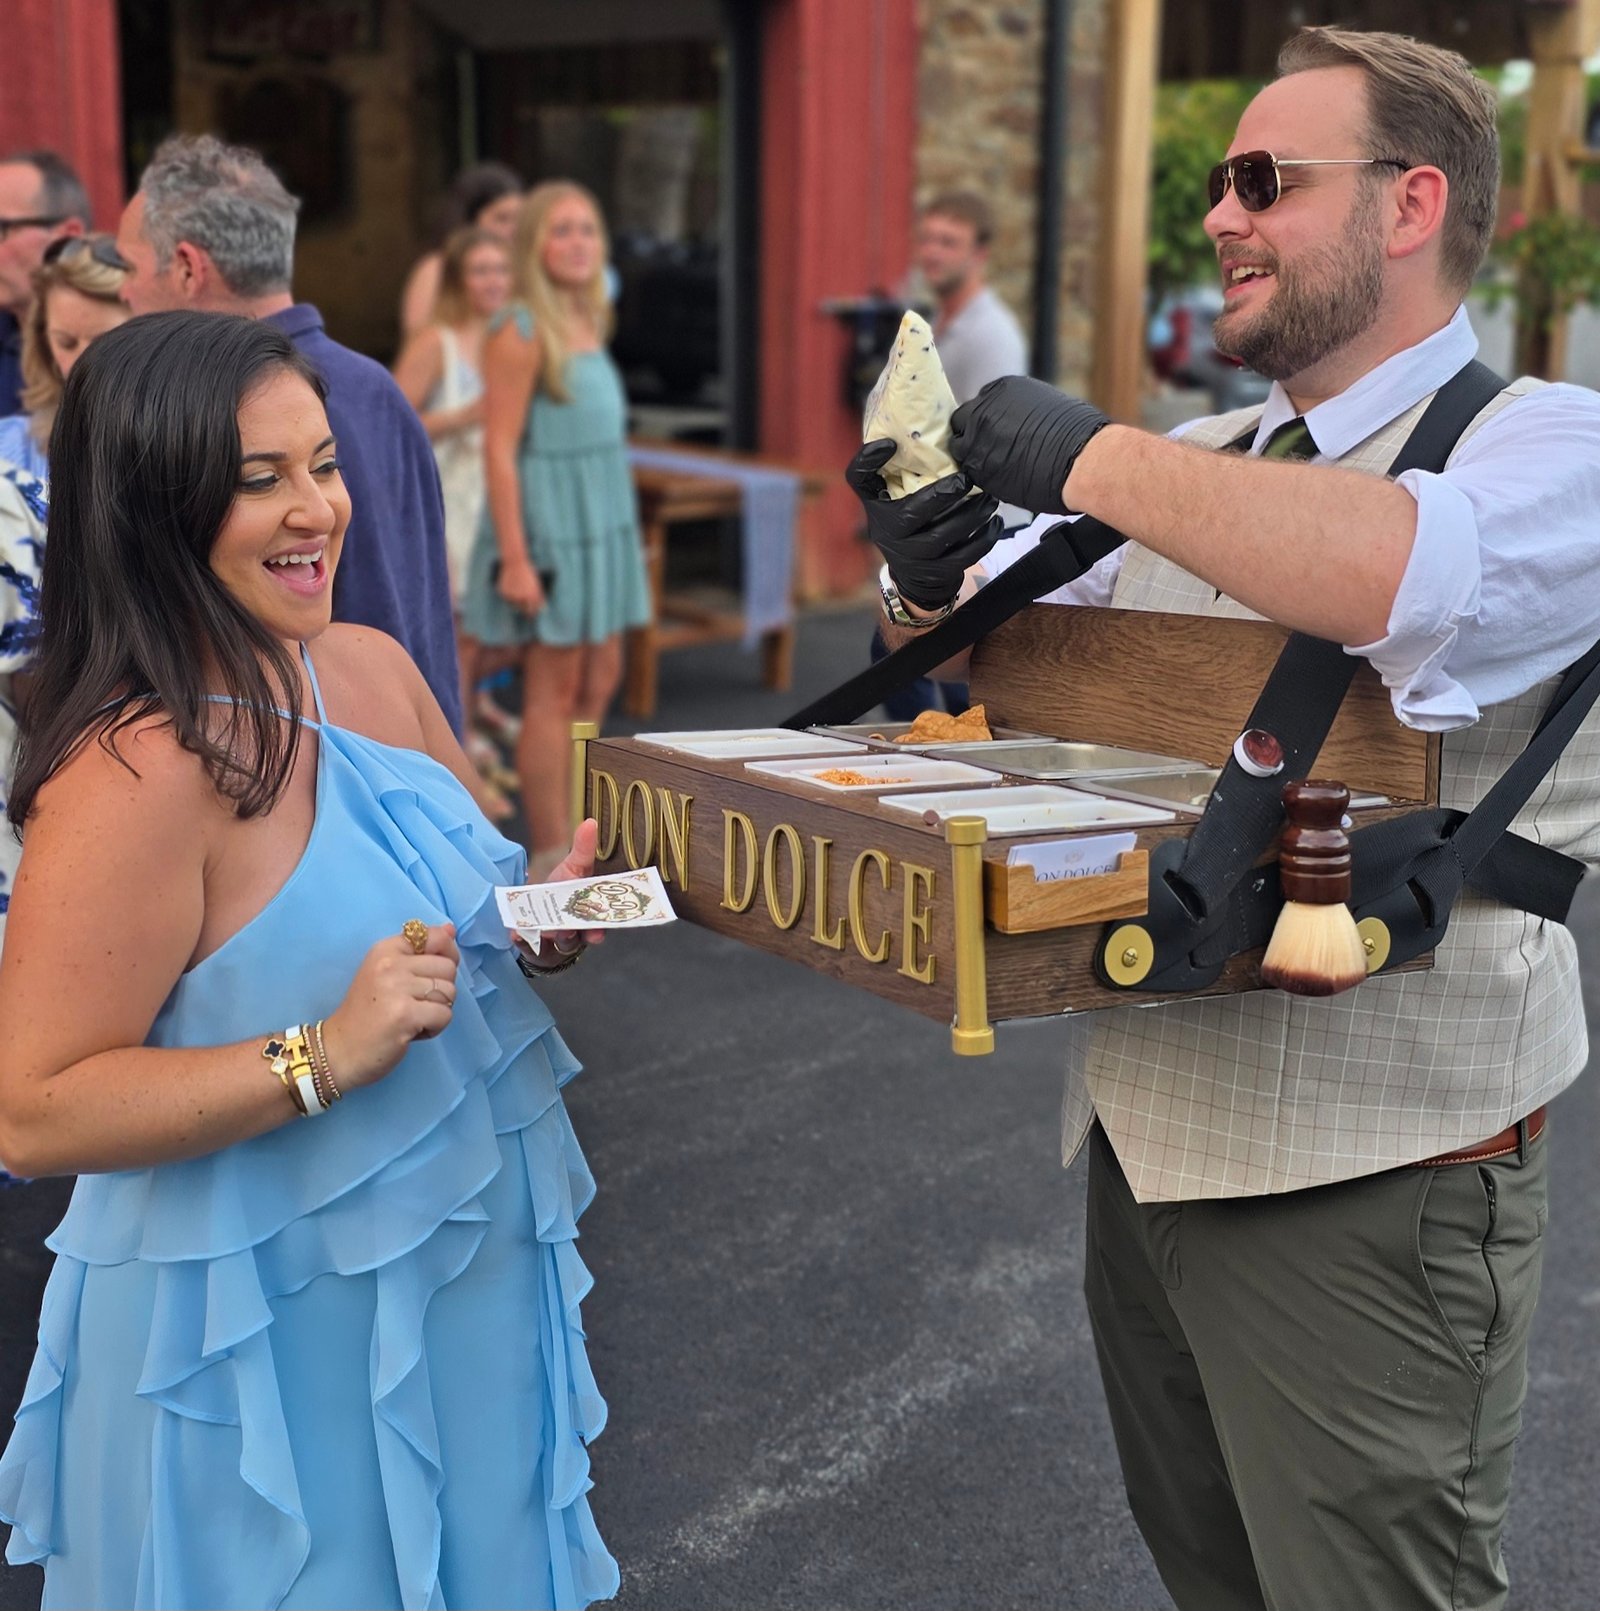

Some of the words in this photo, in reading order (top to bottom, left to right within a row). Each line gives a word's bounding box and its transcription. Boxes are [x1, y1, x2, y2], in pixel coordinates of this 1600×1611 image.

[590, 768, 694, 892] DON
[719, 808, 936, 985] DOLCE
[1033, 870, 1060, 882] ON
